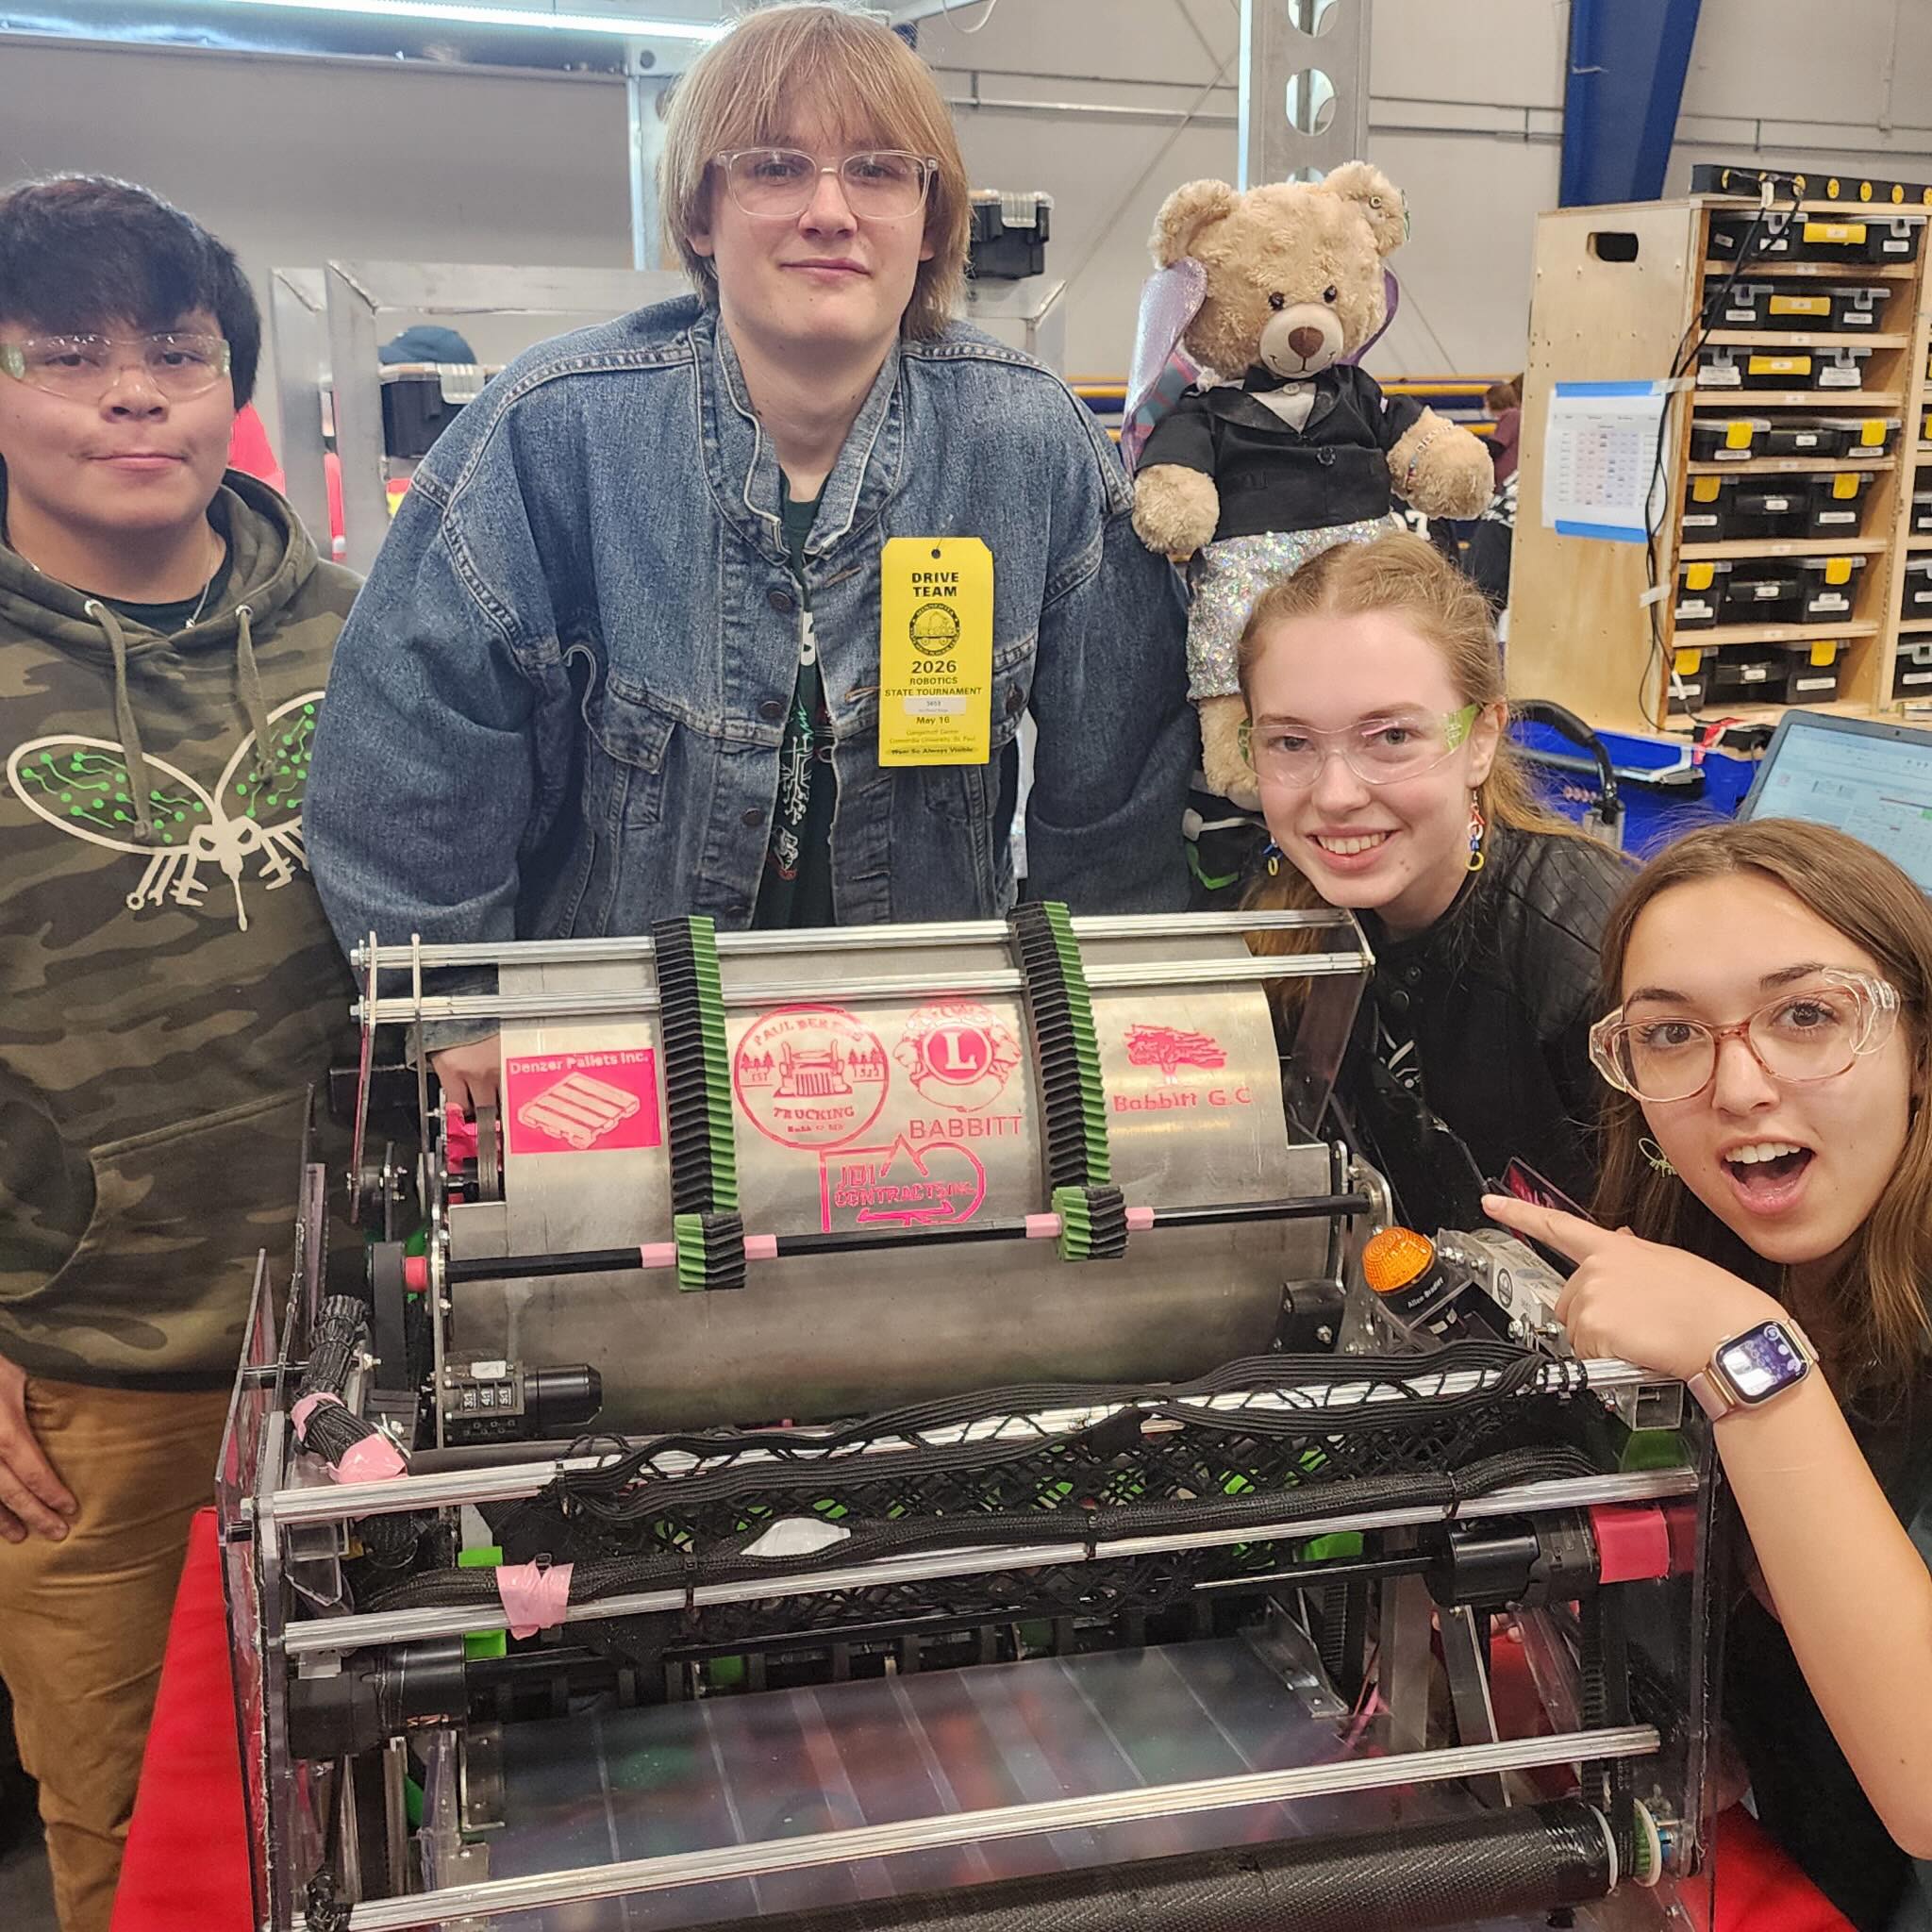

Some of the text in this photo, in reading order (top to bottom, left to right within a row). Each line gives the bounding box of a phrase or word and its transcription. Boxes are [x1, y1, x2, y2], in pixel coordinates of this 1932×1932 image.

[911, 572, 959, 583] DRIVE
[912, 586, 958, 597] TEAM
[911, 660, 957, 674] 2026
[909, 676, 958, 686] ROBOTICS
[885, 687, 982, 697] STATE TOURNAMENT
[916, 716, 936, 725] May
[754, 1021, 794, 1046] PAUL
[941, 1032, 977, 1070] L
[509, 1052, 649, 1074] Denzer Pallets Inc.
[774, 1106, 855, 1121] TRUCKING
[909, 1116, 1023, 1140] BABBITT
[463, 1392, 474, 1407] 3:1
[480, 1390, 491, 1406] 4:1
